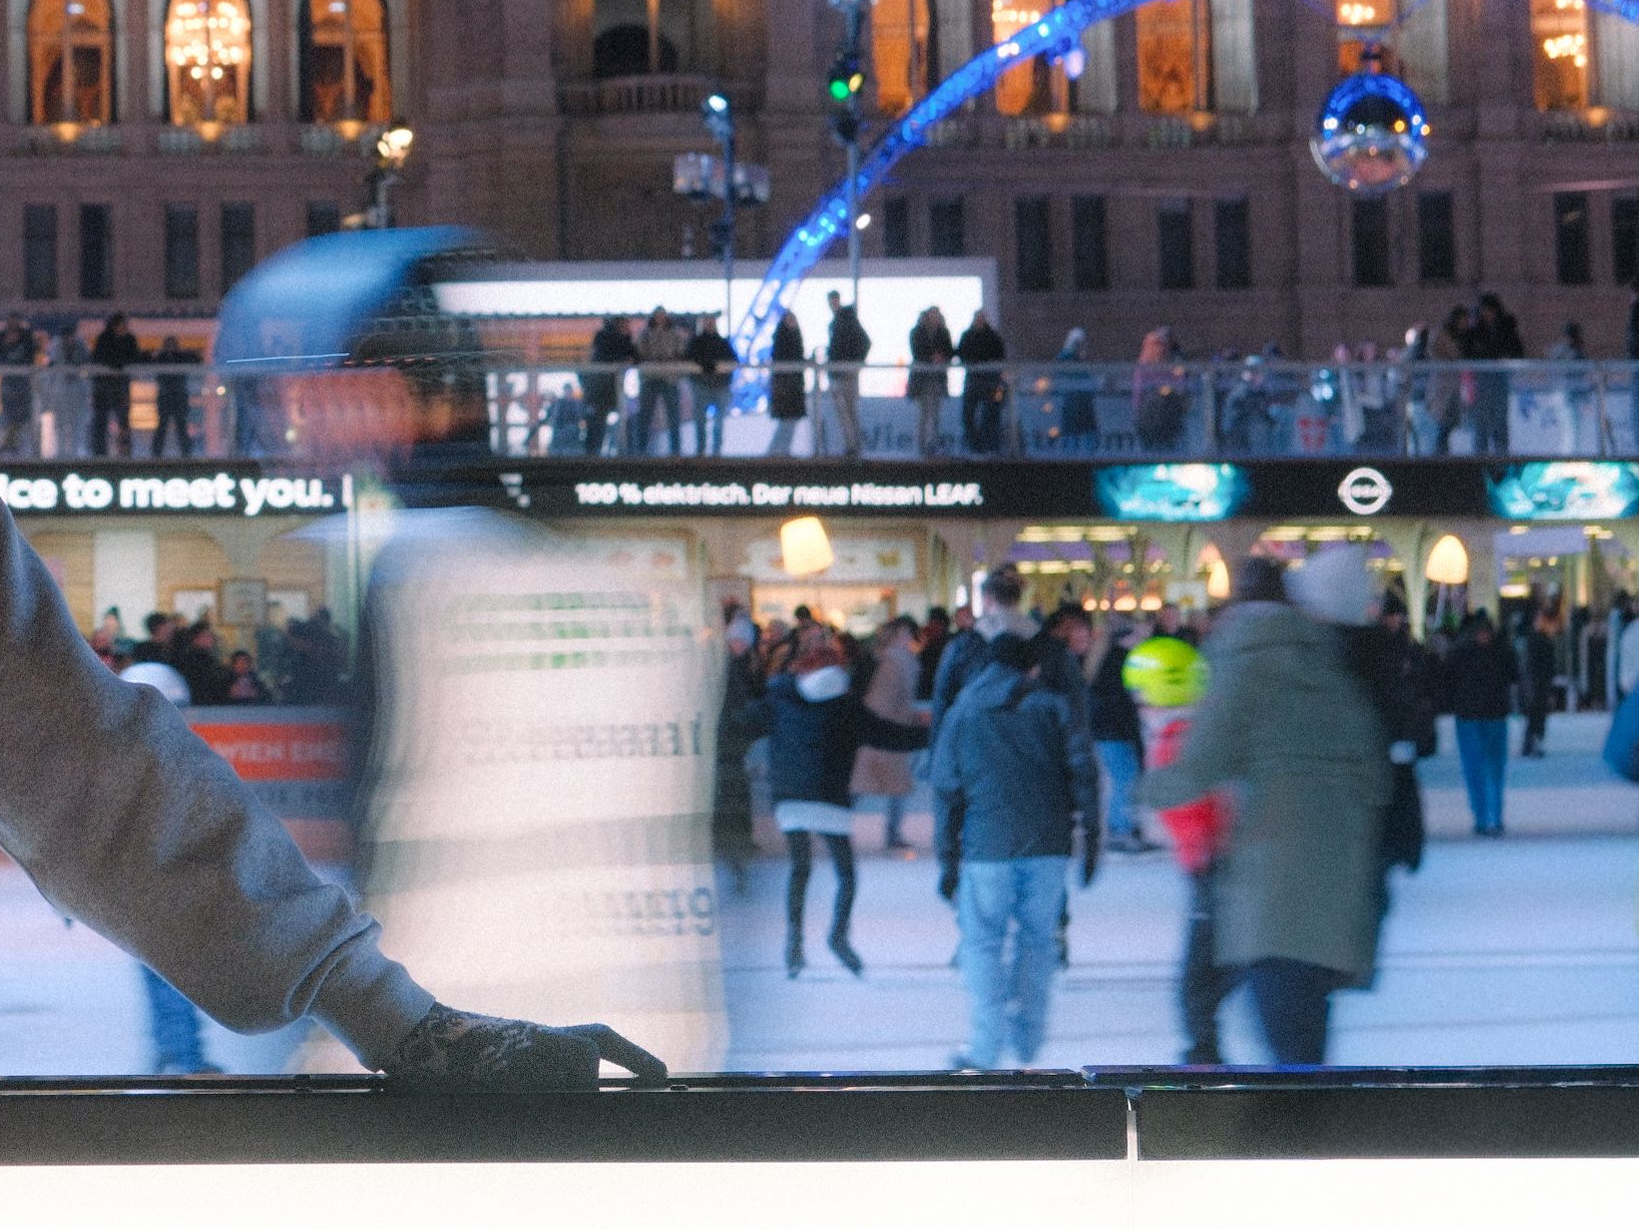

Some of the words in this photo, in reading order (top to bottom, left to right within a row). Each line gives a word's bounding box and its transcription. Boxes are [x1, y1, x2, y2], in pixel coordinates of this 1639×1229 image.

[62, 472, 113, 509] to
[119, 472, 236, 509] meet
[239, 477, 334, 516] you.
[574, 482, 618, 505] 100
[643, 481, 752, 506] elektrisch.
[751, 482, 793, 506] Der
[793, 484, 850, 506] neue
[850, 482, 924, 506] Nissan
[923, 482, 985, 506] LEAF.
